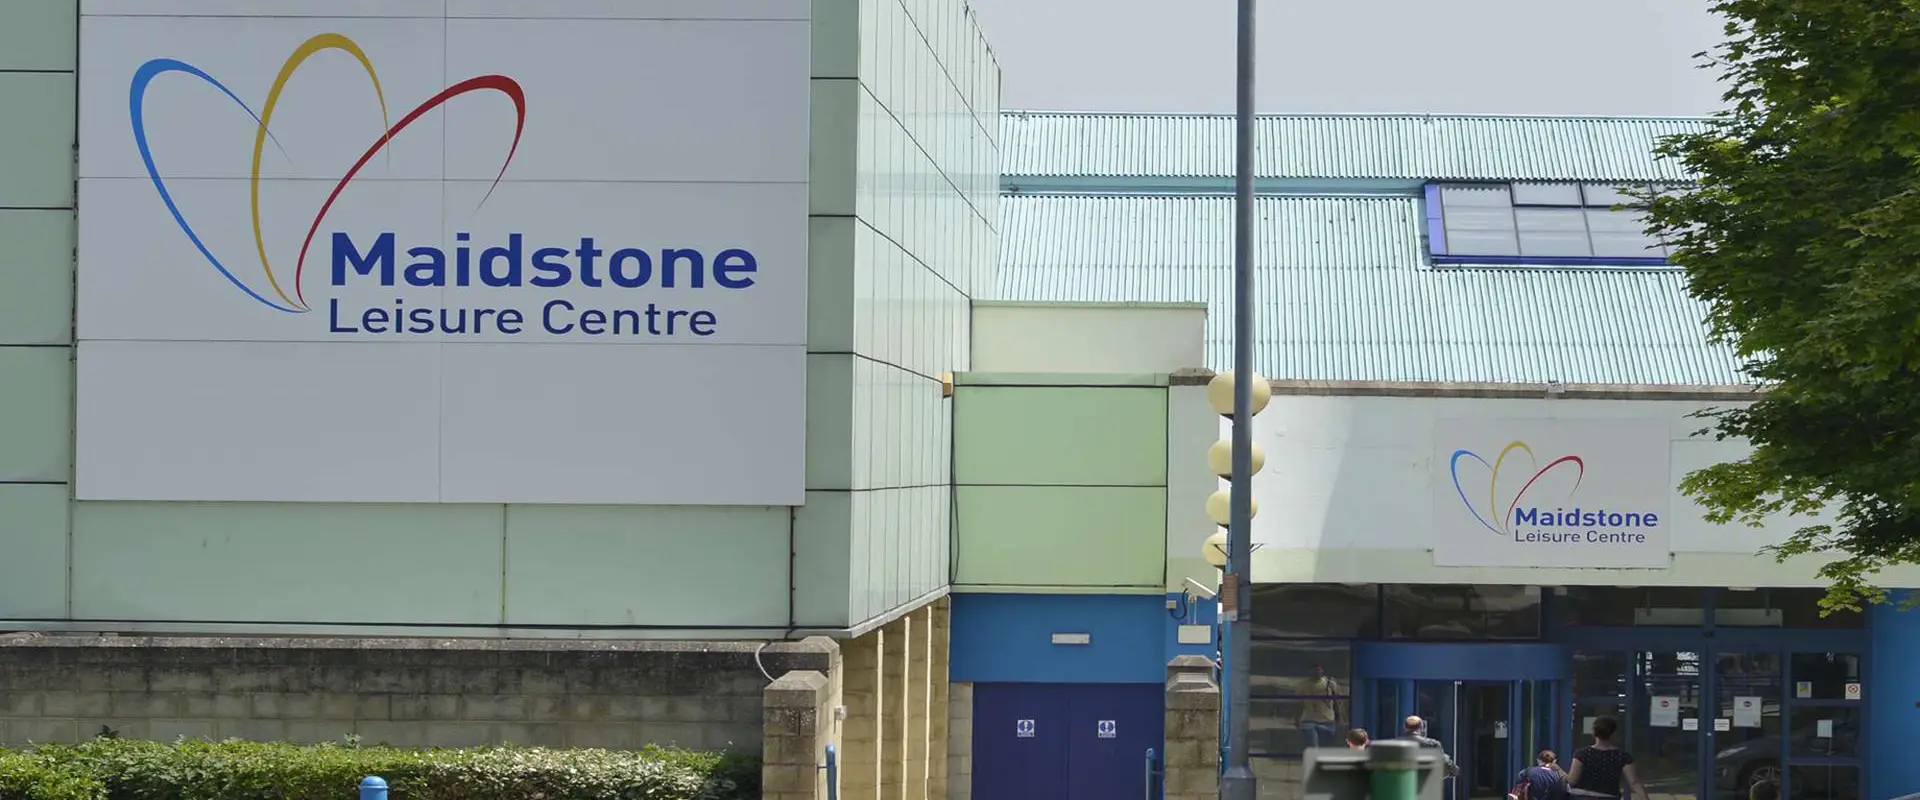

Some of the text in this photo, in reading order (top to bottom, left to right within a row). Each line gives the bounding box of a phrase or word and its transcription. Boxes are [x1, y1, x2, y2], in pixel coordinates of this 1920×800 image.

[331, 232, 758, 289] Maidstone
[329, 298, 717, 336] Leisure Centre
[1514, 507, 1659, 527] Maidstone
[1514, 529, 1646, 543] Leisure Centre
